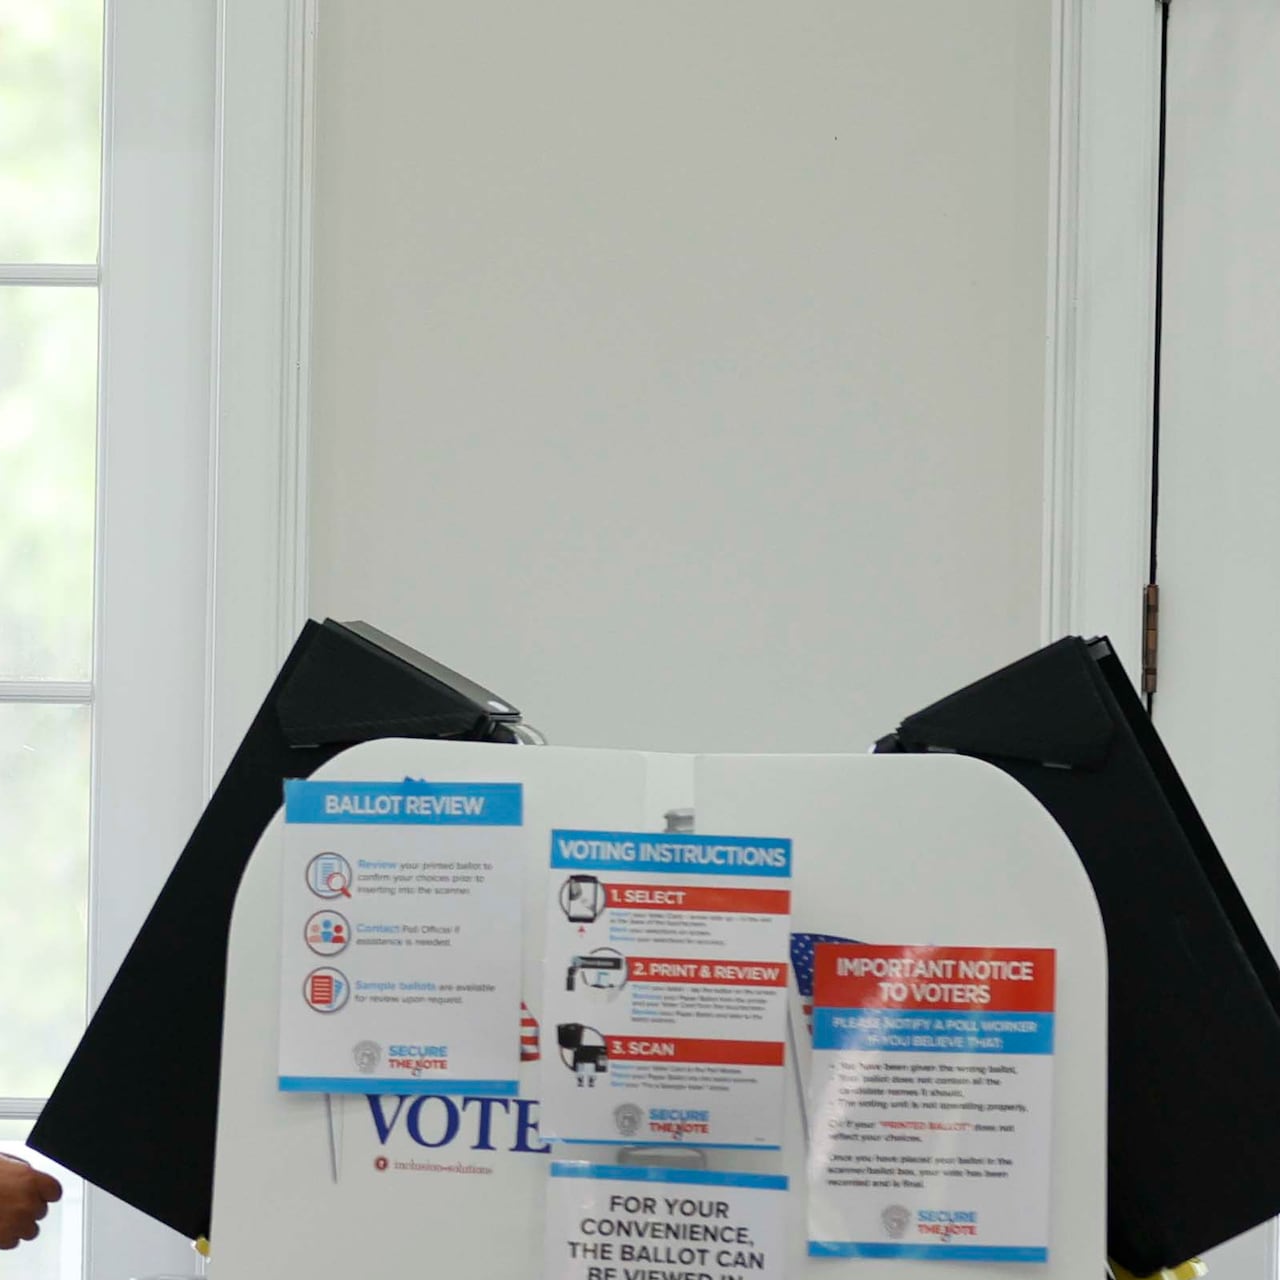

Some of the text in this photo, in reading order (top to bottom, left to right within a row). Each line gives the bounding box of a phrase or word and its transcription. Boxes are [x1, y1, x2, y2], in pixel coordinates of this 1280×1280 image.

[325, 795, 484, 816] BALLOT REVIEW
[559, 839, 786, 868] VOTING INSTRUCTIONS
[611, 889, 687, 905] 1. SELECT
[633, 962, 780, 981] 2. PRINT & REVIEW
[837, 958, 1035, 981] IMPORTANT NOTICE
[878, 982, 991, 1004] TO VOTERS
[833, 1017, 1038, 1033] PLEASE NOTIFY A POLL WORKER
[389, 1045, 448, 1057] SECURE
[611, 1041, 675, 1057] 3. SCAN
[912, 1036, 963, 1048] BELIEVE
[365, 1093, 552, 1154] VOTE
[649, 1108, 710, 1121] SECURE
[610, 1195, 729, 1219] FOR YOUR
[918, 1210, 978, 1223] SECURE
[580, 1218, 755, 1247] CONVENIENCE,
[568, 1241, 765, 1270] THE BALLOT CAN
